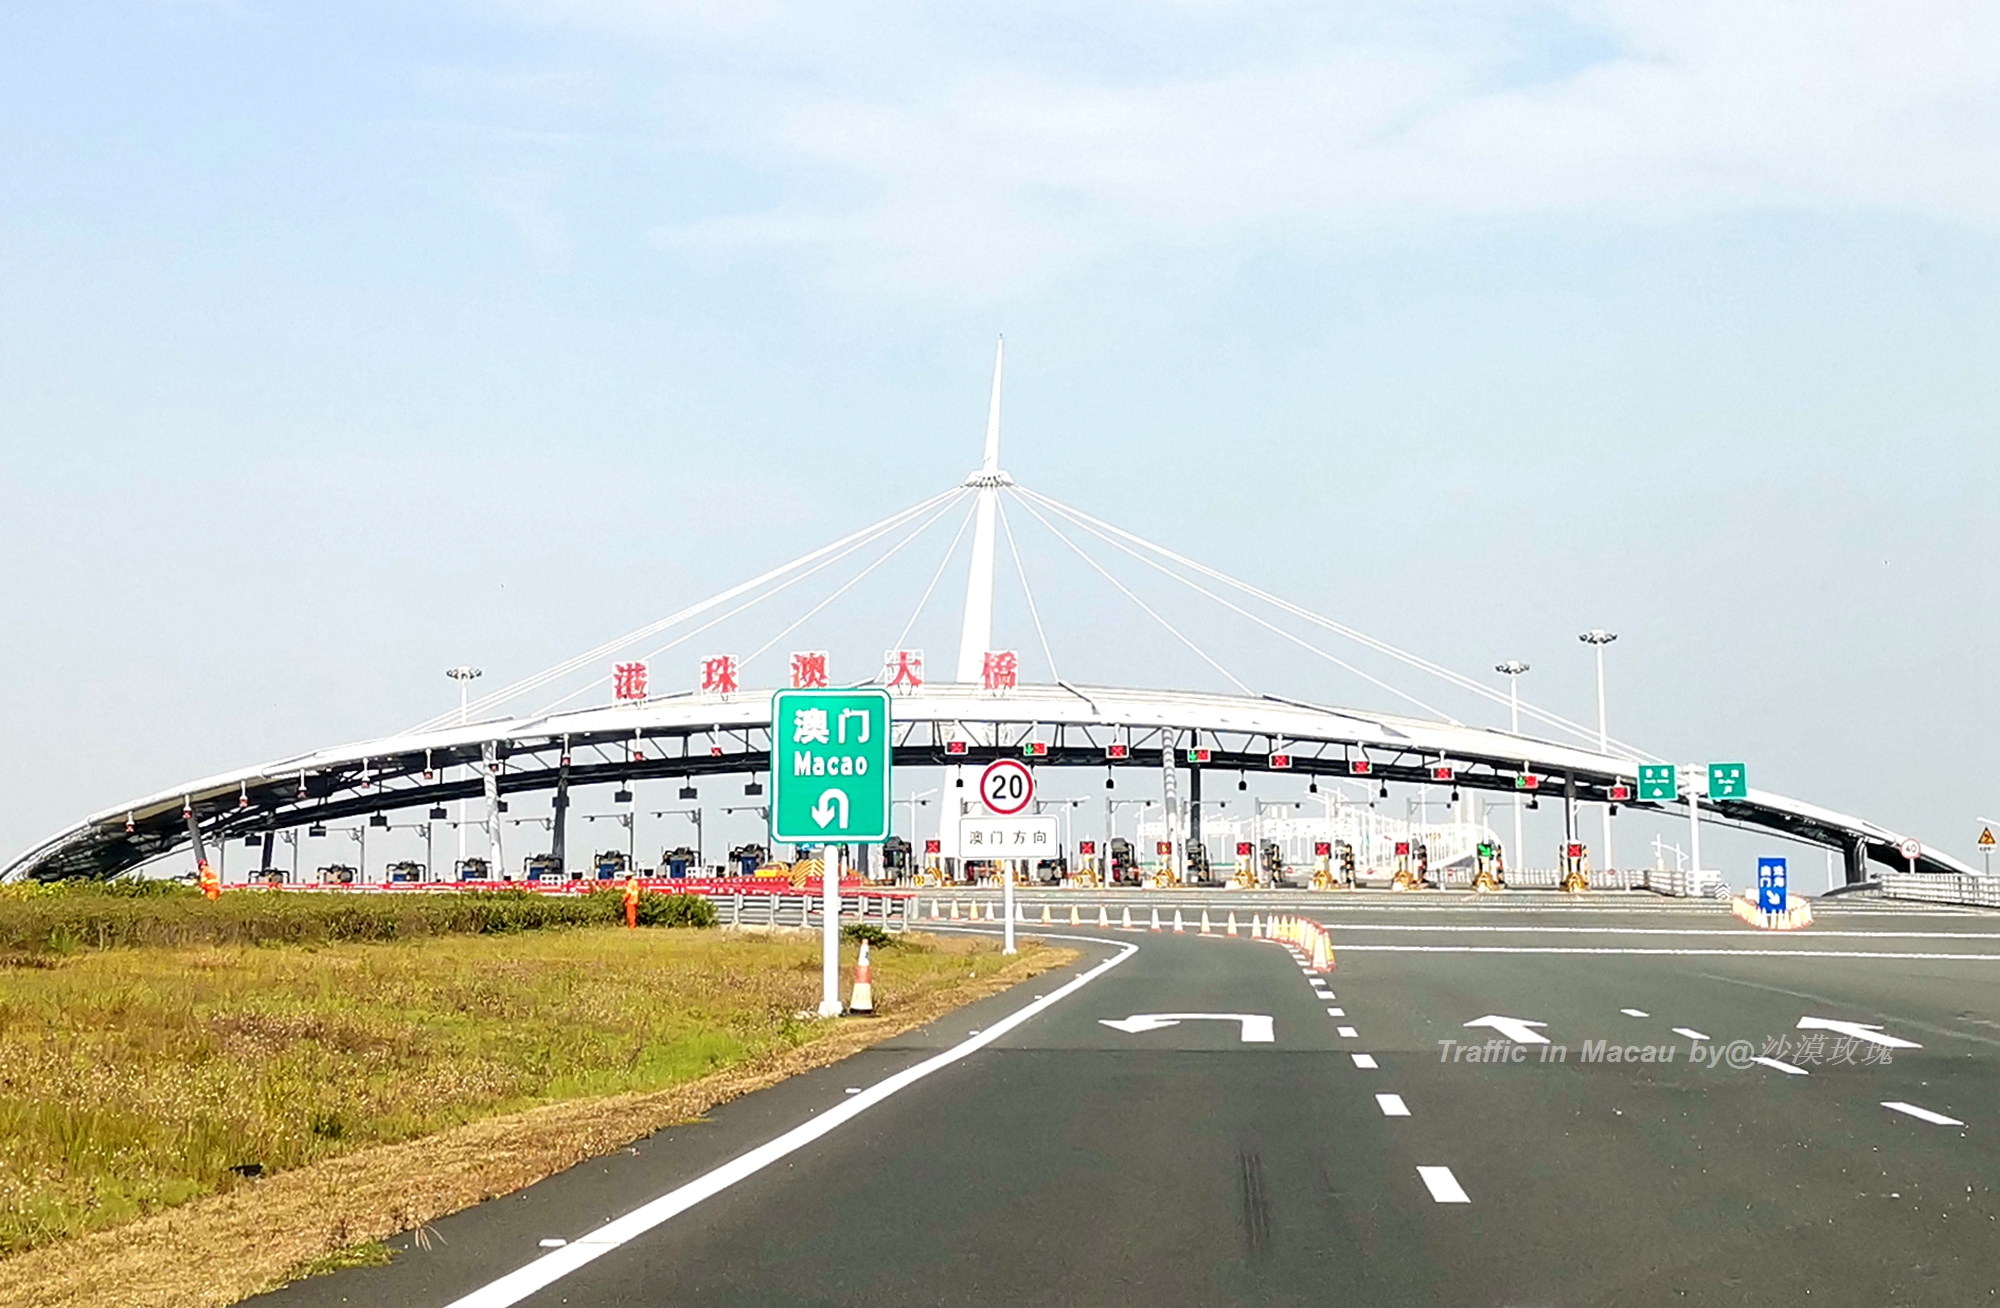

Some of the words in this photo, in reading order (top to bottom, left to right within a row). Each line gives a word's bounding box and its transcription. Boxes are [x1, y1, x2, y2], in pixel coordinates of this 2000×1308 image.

[614, 650, 1018, 700] 港珠澳大橋
[793, 707, 870, 745] 澳门
[794, 750, 868, 776] Macao
[992, 774, 1023, 799] 20
[969, 829, 1047, 845] 澳门方向
